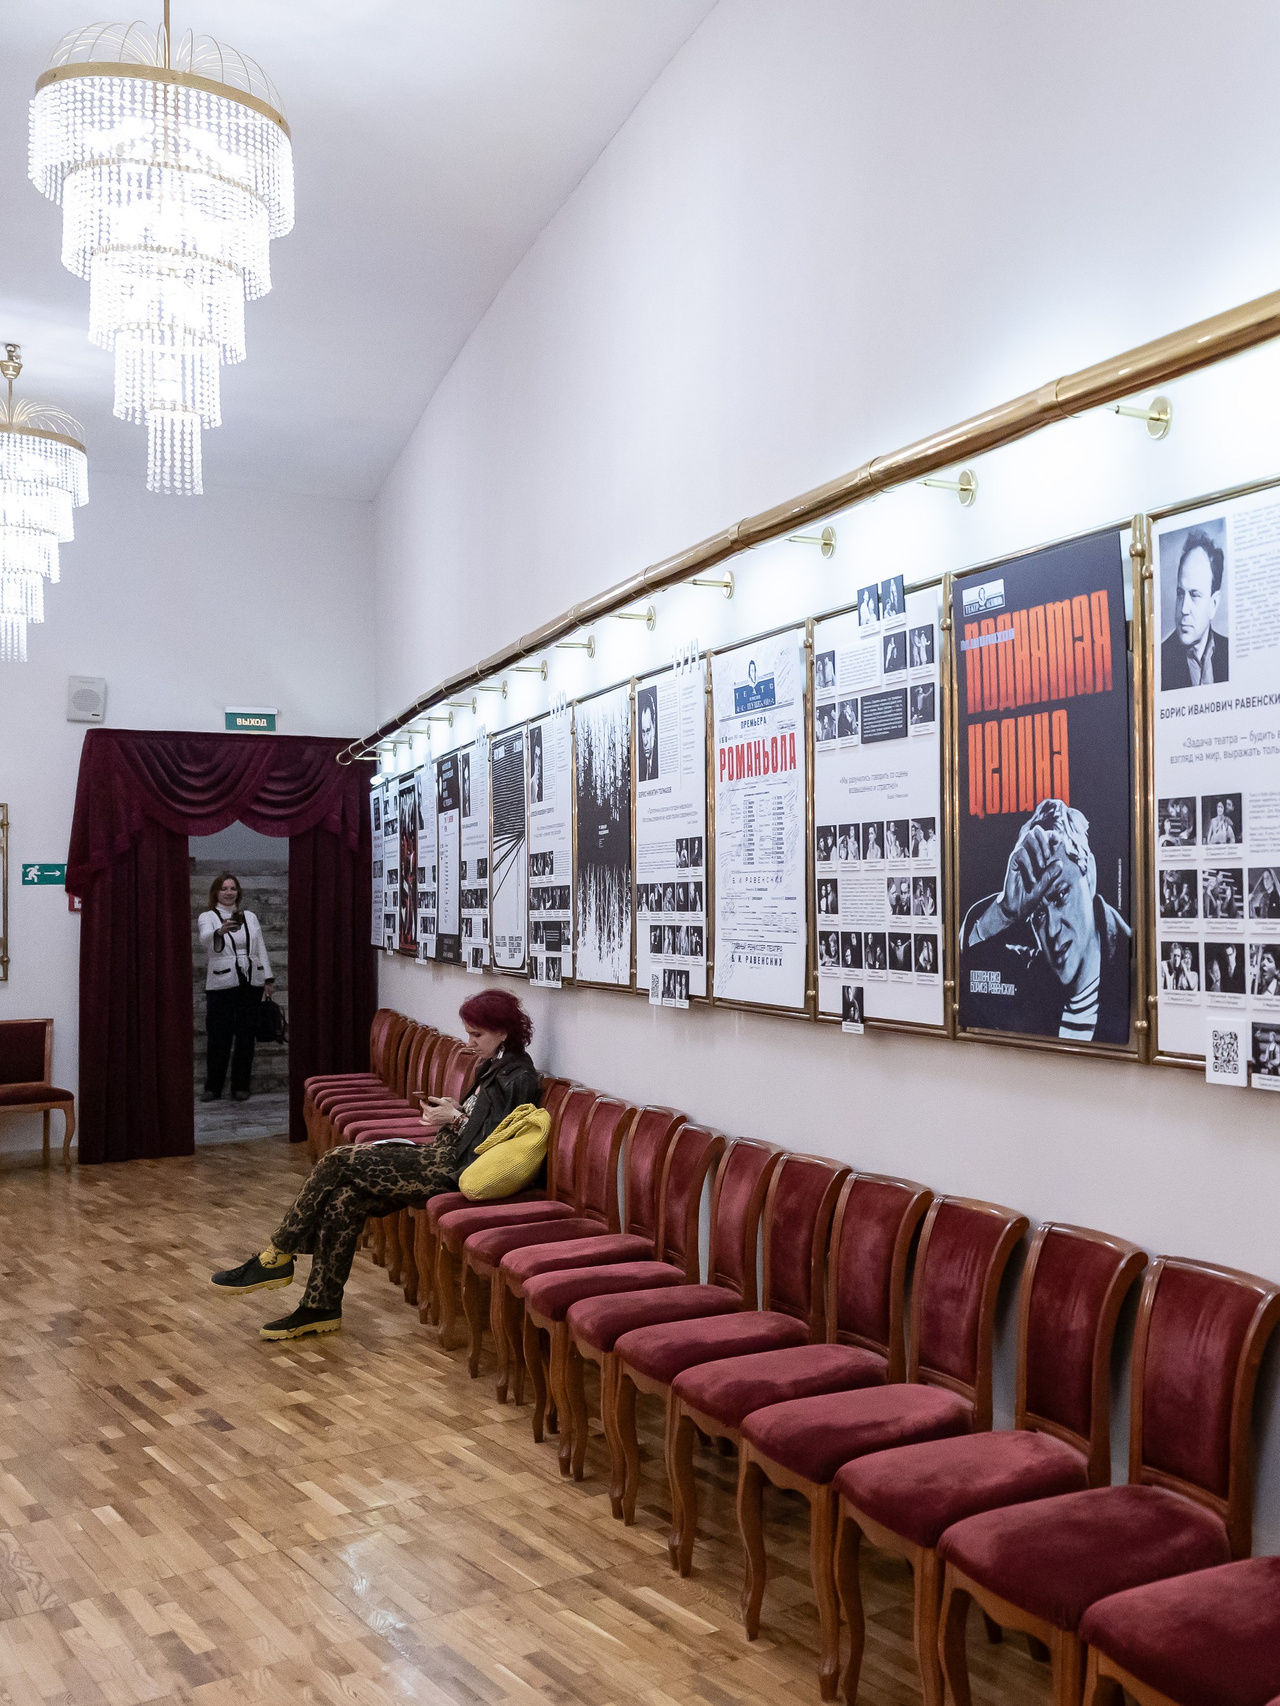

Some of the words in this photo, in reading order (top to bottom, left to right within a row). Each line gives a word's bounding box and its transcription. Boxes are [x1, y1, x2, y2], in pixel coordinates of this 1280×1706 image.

[1160, 706, 1187, 719] БОРИС
[1187, 700, 1234, 717] ИВАНОВИЧ
[236, 717, 268, 727] ВЫХОД
[1213, 735, 1239, 747] театра
[1249, 730, 1276, 744] будить
[719, 732, 797, 783] РОМАНЬОЛА
[1195, 753, 1204, 762] на
[1223, 747, 1261, 761] выражать
